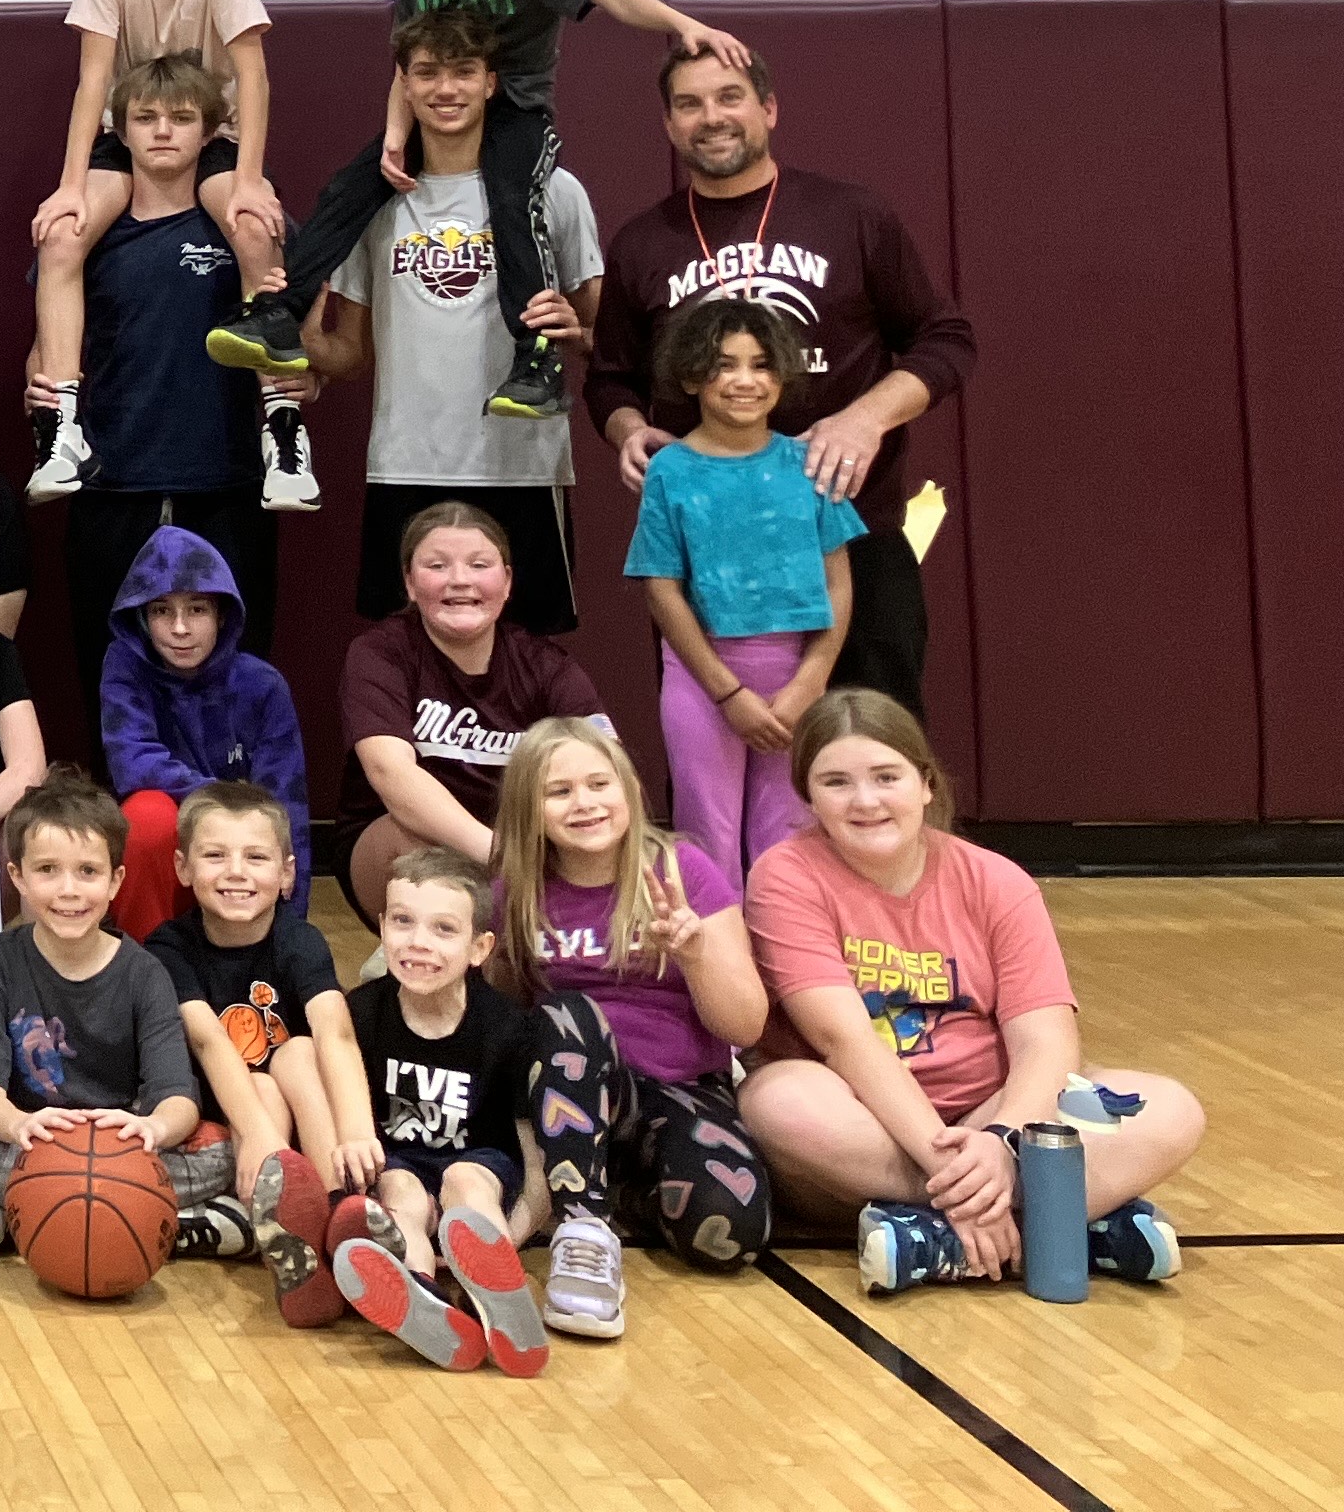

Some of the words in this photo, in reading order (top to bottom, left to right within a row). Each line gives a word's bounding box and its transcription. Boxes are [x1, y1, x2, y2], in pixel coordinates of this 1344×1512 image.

[391, 244, 496, 277] EAGLE
[846, 963, 950, 1002] PRING
[385, 1057, 471, 1110] I'VE
